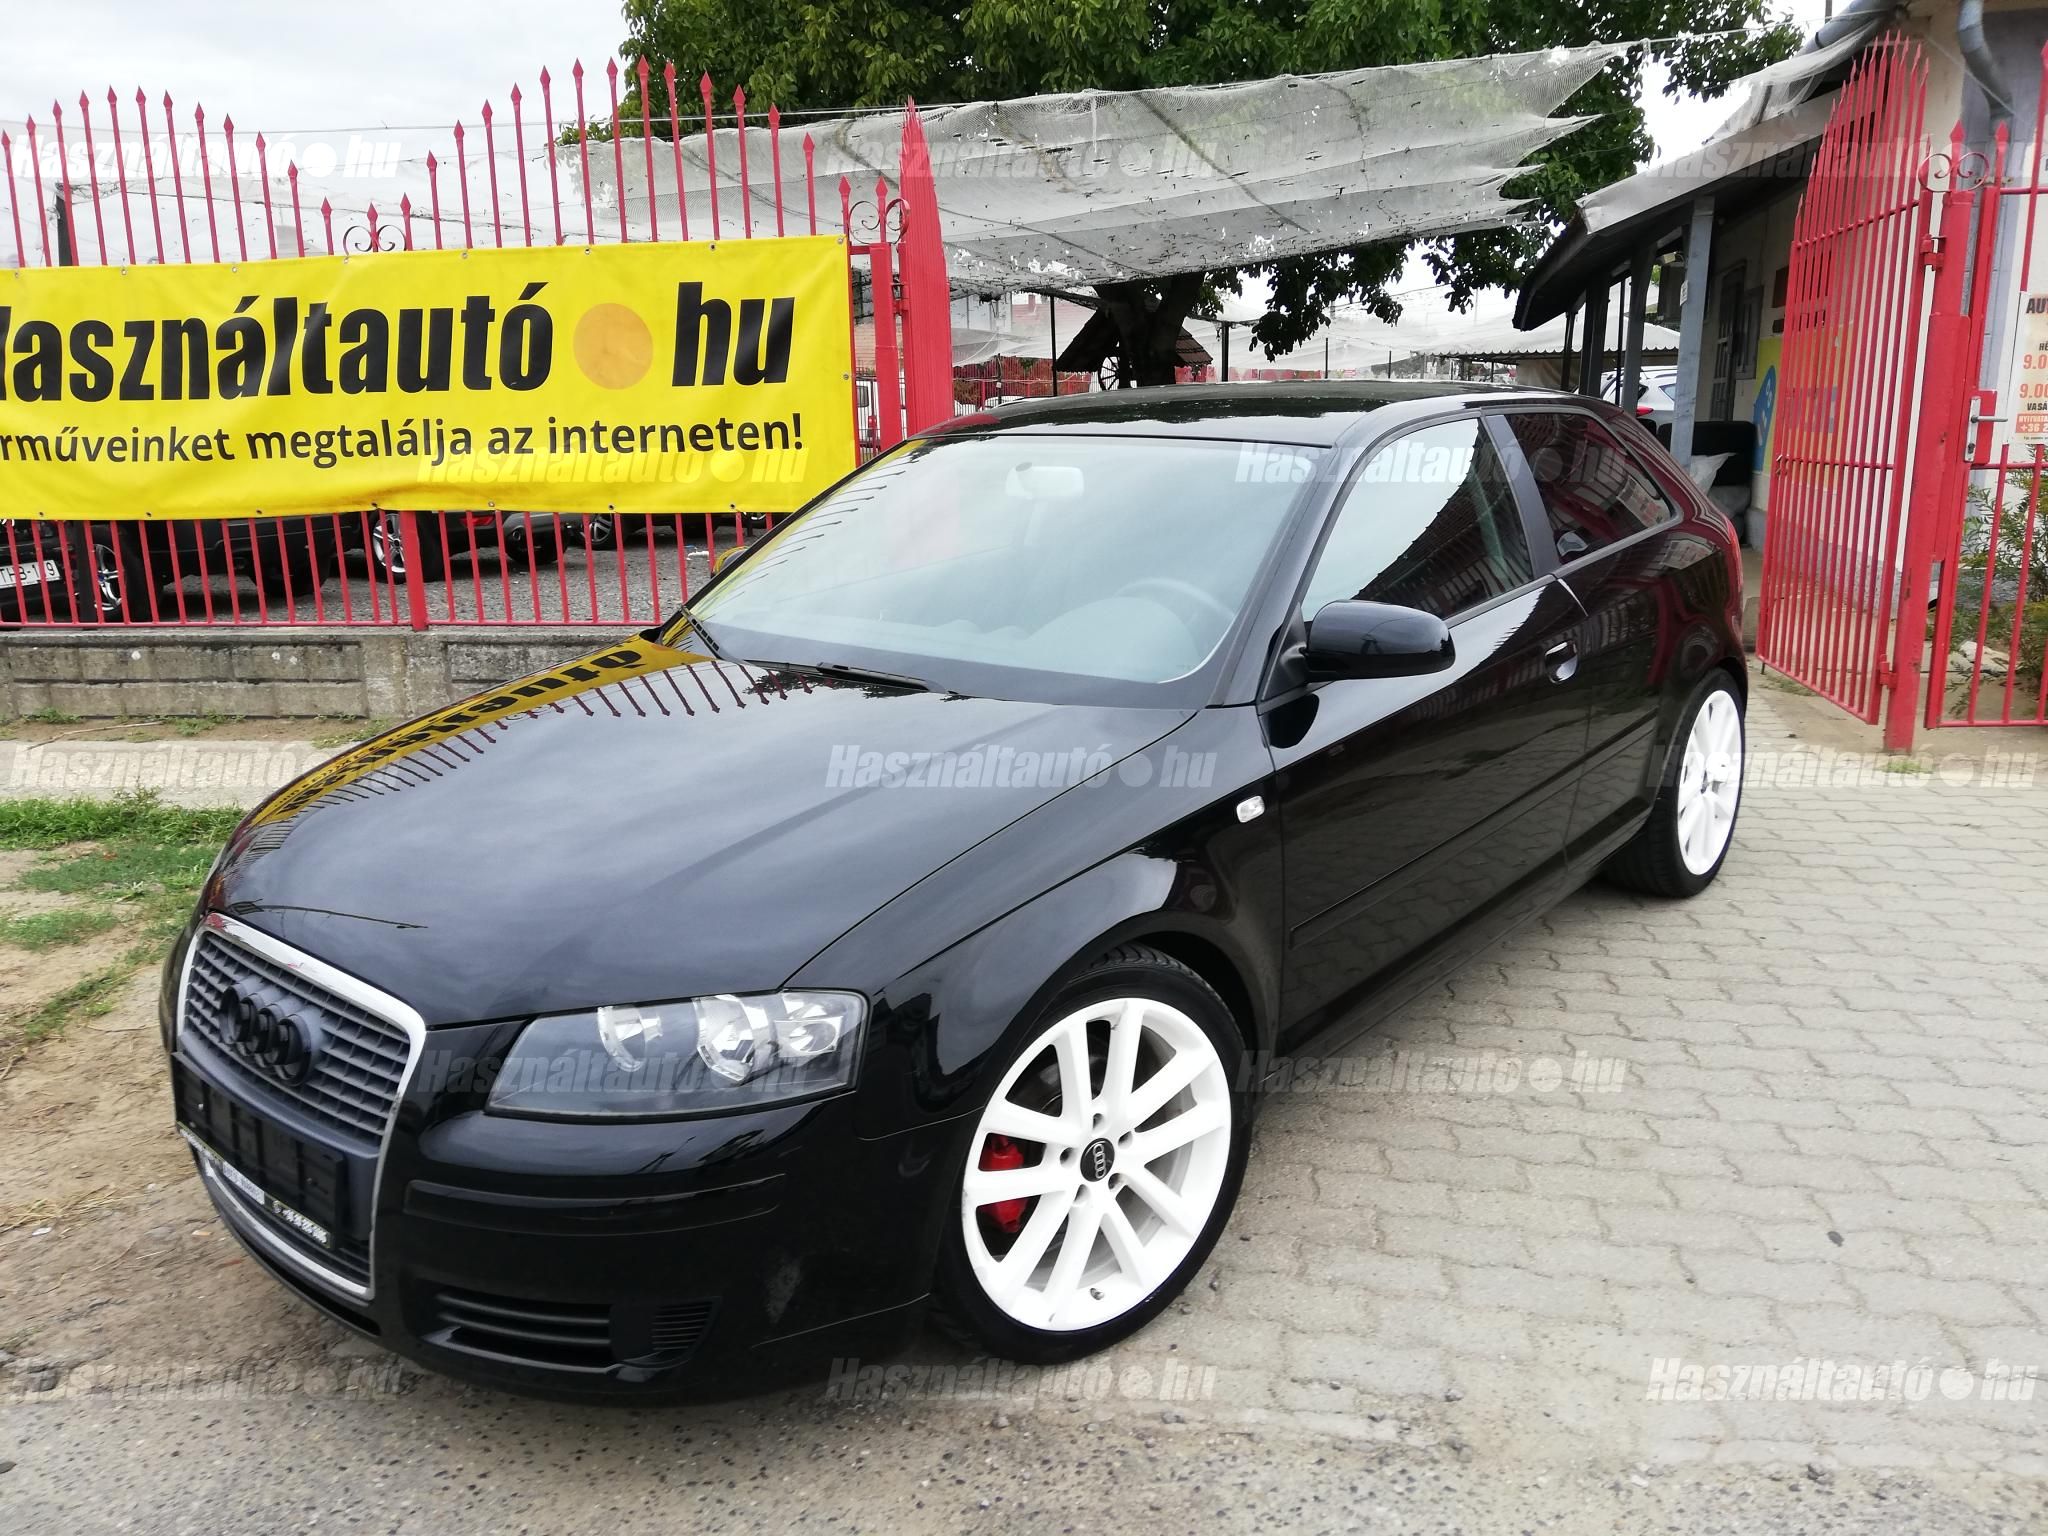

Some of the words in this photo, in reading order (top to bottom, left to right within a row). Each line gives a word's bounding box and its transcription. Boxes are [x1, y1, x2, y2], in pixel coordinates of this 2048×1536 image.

[2026, 298, 2048, 314] AU
[0, 281, 553, 402] asználtautó
[245, 419, 472, 468] megtalálja
[487, 427, 534, 456] az
[548, 413, 803, 455] interneten!
